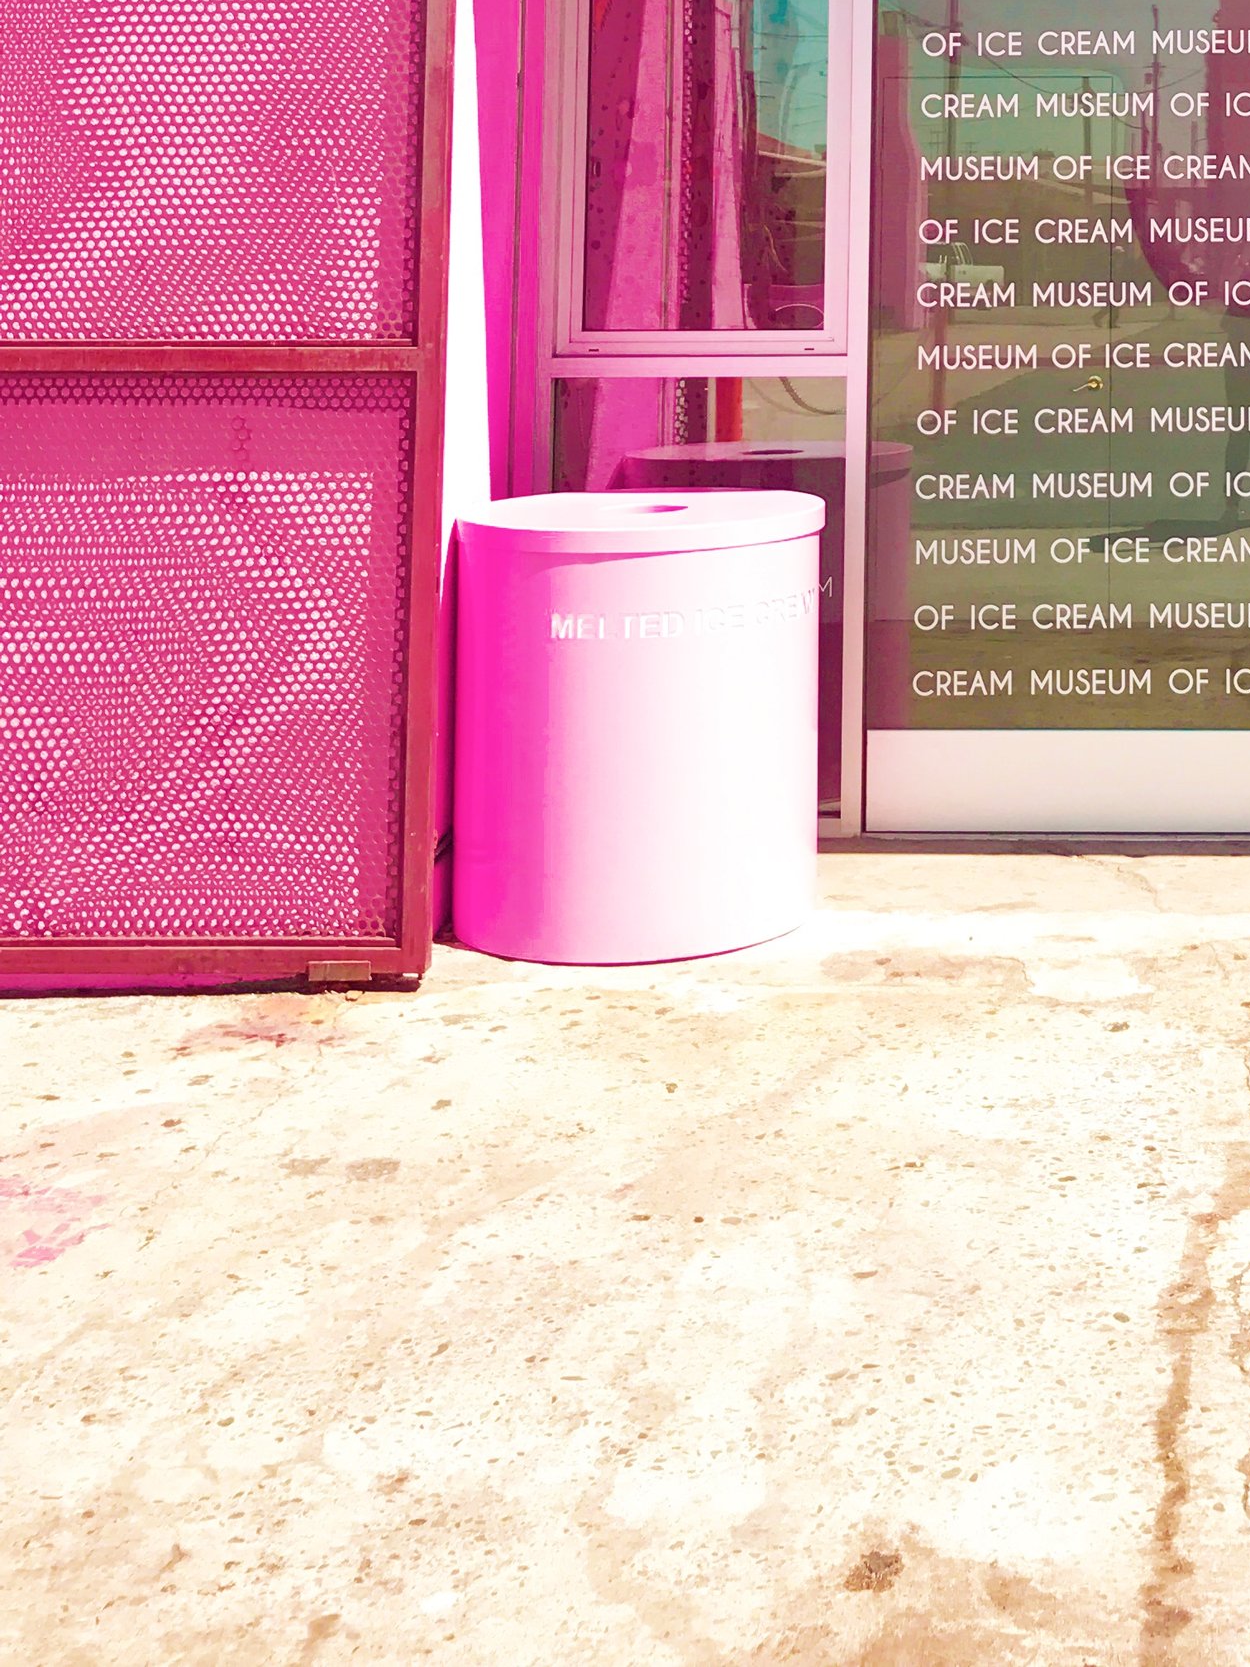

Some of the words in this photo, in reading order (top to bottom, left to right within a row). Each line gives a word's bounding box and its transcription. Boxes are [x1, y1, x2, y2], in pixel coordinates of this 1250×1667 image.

[921, 32, 962, 57] OF
[977, 31, 1022, 57] ICE
[1037, 30, 1135, 56] CREAM
[920, 93, 1019, 119] CREAM
[1036, 92, 1154, 118] MUSEUM
[1169, 92, 1210, 117] OF
[920, 155, 1039, 181] MUSEUM
[1052, 155, 1093, 181] OF
[1105, 154, 1151, 180] ICE
[918, 219, 958, 245] OF
[974, 218, 1019, 244] ICE
[1034, 218, 1133, 244] CREAM
[916, 282, 1015, 308] CREAM
[1032, 281, 1152, 308] MUSEUM
[1168, 281, 1208, 307] OF
[917, 344, 1038, 371] MUSEUM
[1051, 343, 1092, 369] OF
[1105, 343, 1151, 369] ICE
[916, 409, 957, 435] OF
[973, 408, 1019, 435] ICE
[1034, 407, 1133, 434] CREAM
[915, 473, 1015, 500] CREAM
[1032, 472, 1153, 499] MUSEUM
[1169, 471, 1210, 498] OF
[915, 538, 1036, 565] MUSEUM
[1050, 537, 1091, 564] OF
[1104, 537, 1150, 564] ICE
[913, 605, 954, 631] OF
[970, 604, 1016, 630] ICE
[1032, 603, 1132, 630] CREAM
[912, 669, 1013, 697] CREAM
[1030, 668, 1151, 695] MUSEUM
[1168, 668, 1209, 695] OF
